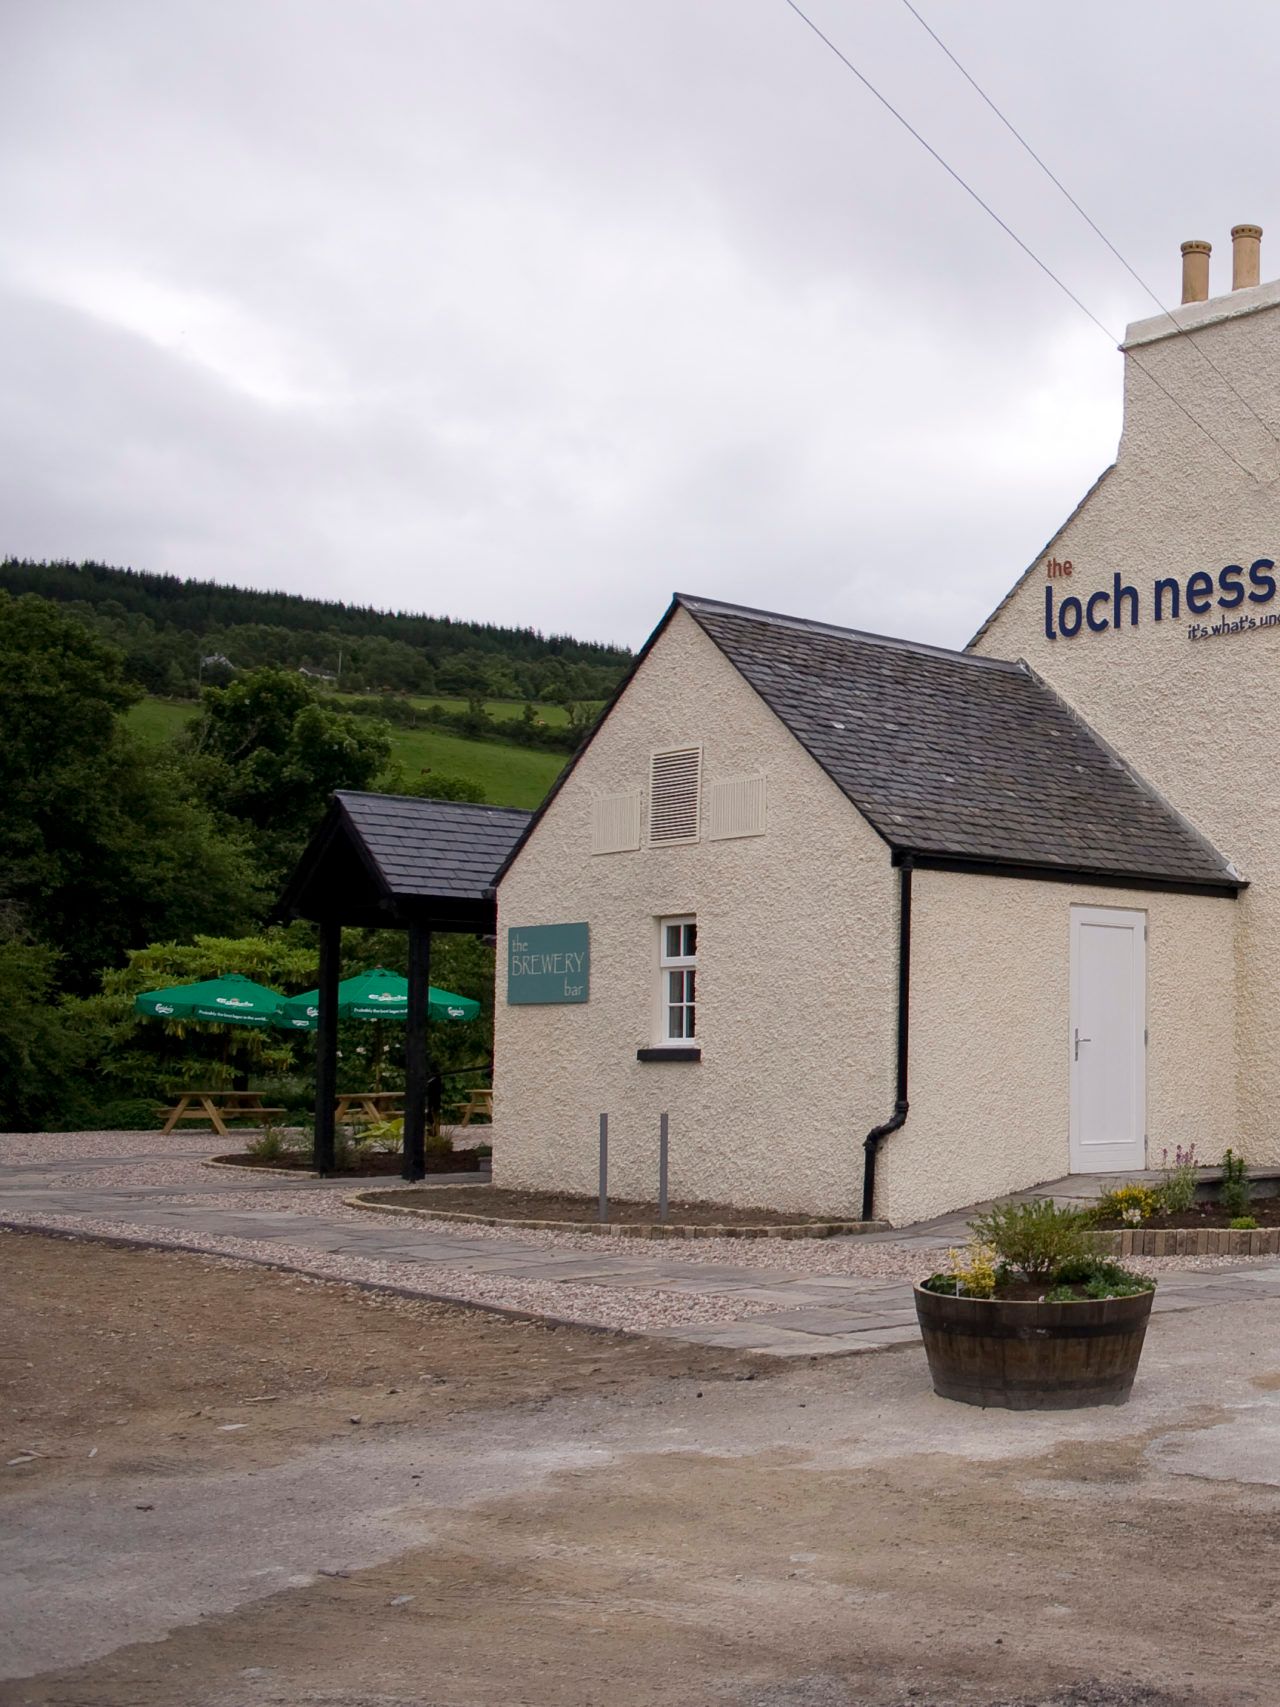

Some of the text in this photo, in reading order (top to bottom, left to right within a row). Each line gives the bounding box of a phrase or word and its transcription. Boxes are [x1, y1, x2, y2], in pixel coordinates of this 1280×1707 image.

[1047, 558, 1072, 578] the
[1045, 572, 1139, 640] loch
[1154, 558, 1276, 621] ness
[1188, 623, 1209, 639] it's
[1211, 614, 1256, 634] what's
[511, 933, 529, 953] the
[511, 952, 585, 976] BREWERY
[564, 976, 585, 997] bar
